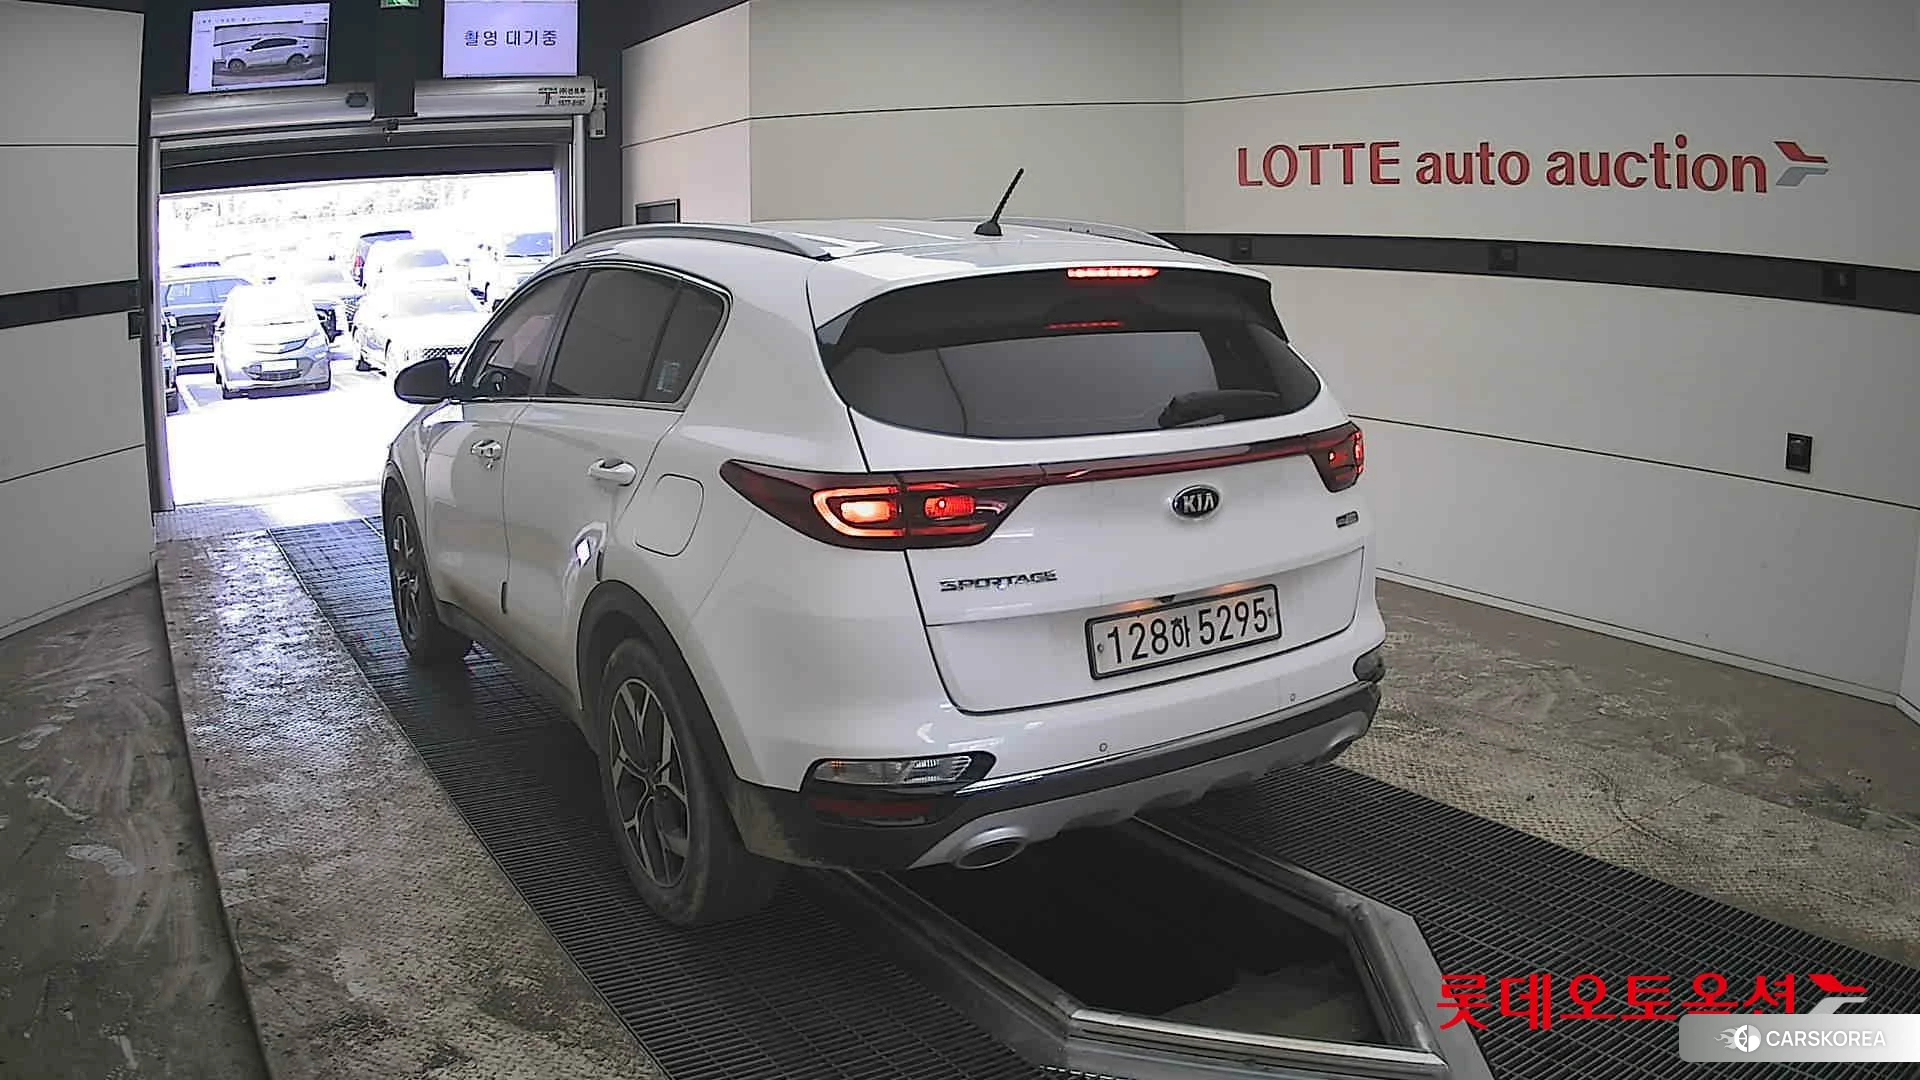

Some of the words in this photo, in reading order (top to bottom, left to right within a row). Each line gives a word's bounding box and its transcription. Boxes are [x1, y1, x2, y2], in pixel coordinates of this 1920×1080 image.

[506, 30, 557, 46] 대기중
[1236, 141, 1400, 188] LOTTE
[1415, 141, 1530, 186] auto
[1546, 133, 1767, 194] auction
[1183, 492, 1215, 513] KIA
[939, 568, 1058, 592] SPORTAGE
[1107, 616, 1191, 664] 128하
[1198, 597, 1268, 645] 5295
